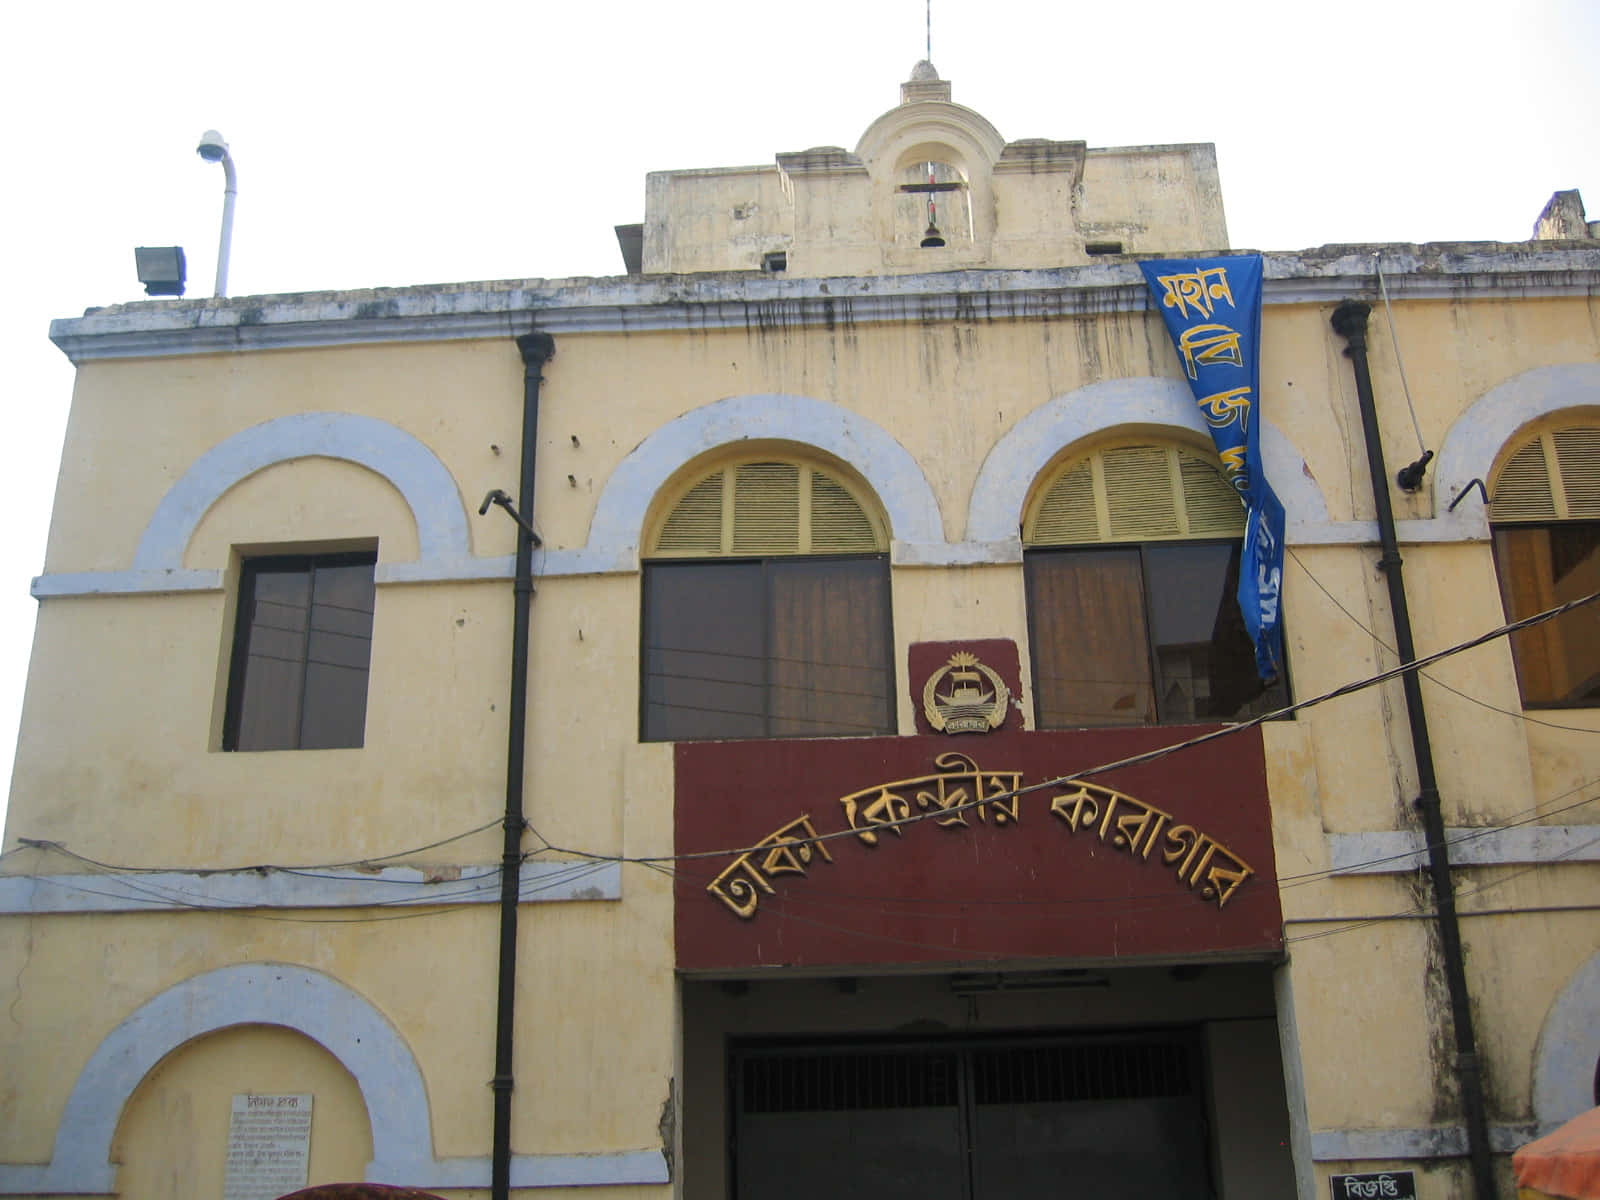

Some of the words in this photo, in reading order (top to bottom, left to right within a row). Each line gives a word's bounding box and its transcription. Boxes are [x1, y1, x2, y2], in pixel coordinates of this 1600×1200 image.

[1157, 267, 1236, 321] মহান
[706, 813, 833, 919] ঢাকা
[840, 752, 1024, 845] কেন্দ্রীয়
[1050, 776, 1255, 908] কারাগার
[1344, 1175, 1399, 1198] বিজ্ঞপ্তি
